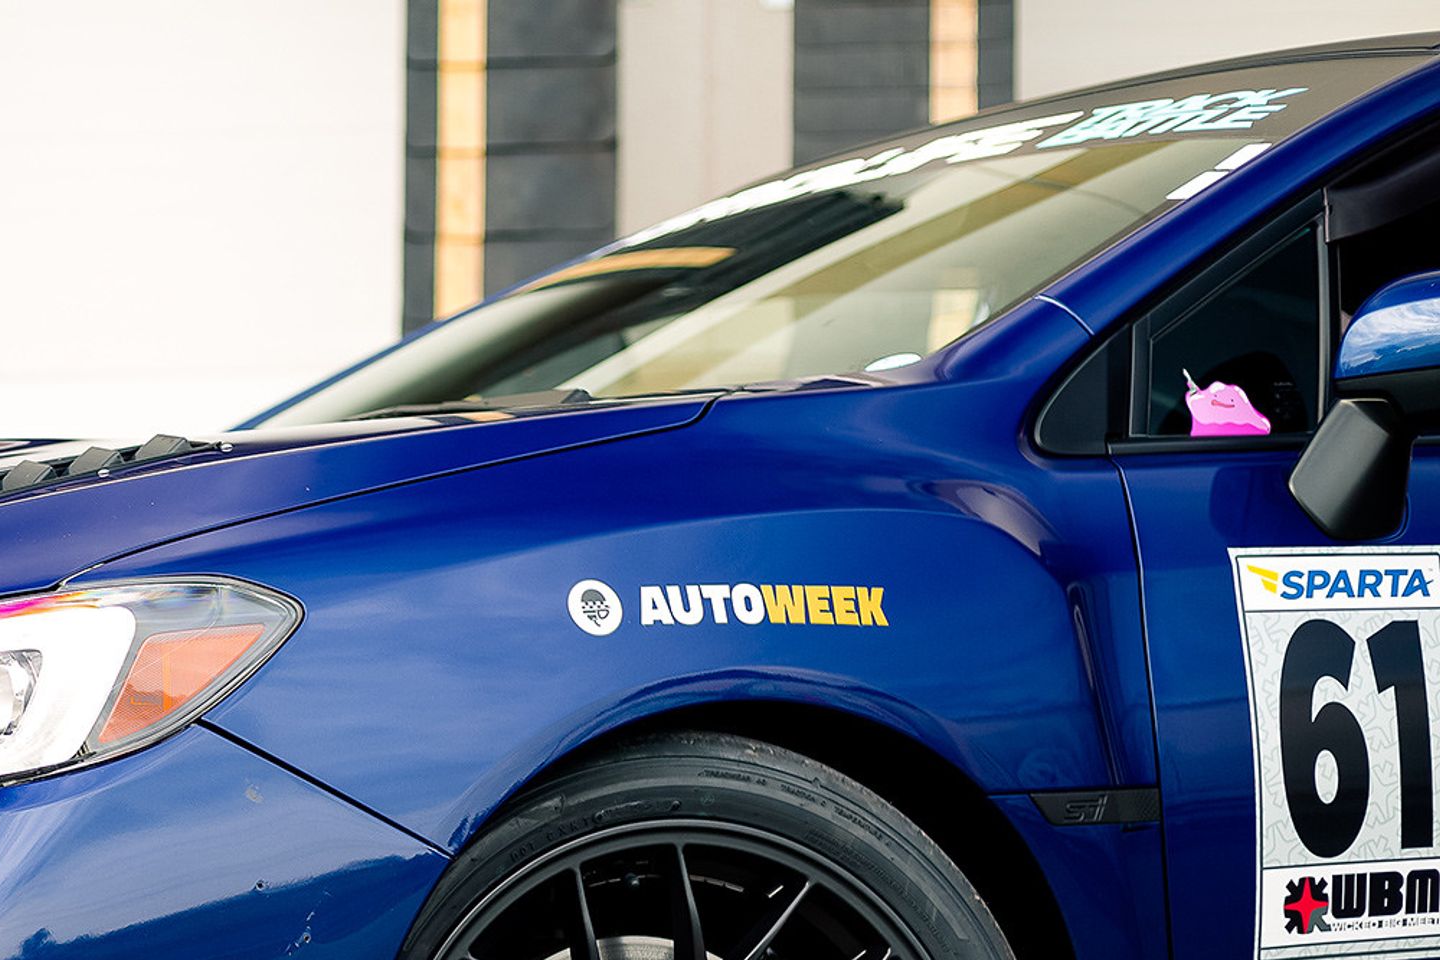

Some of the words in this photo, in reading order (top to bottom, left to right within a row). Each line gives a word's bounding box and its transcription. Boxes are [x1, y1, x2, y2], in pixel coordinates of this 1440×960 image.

[640, 583, 890, 627] AUTOWEEK
[1280, 568, 1434, 600] SPARTA
[1280, 619, 1434, 858] 61
[1331, 869, 1440, 919] WBM
